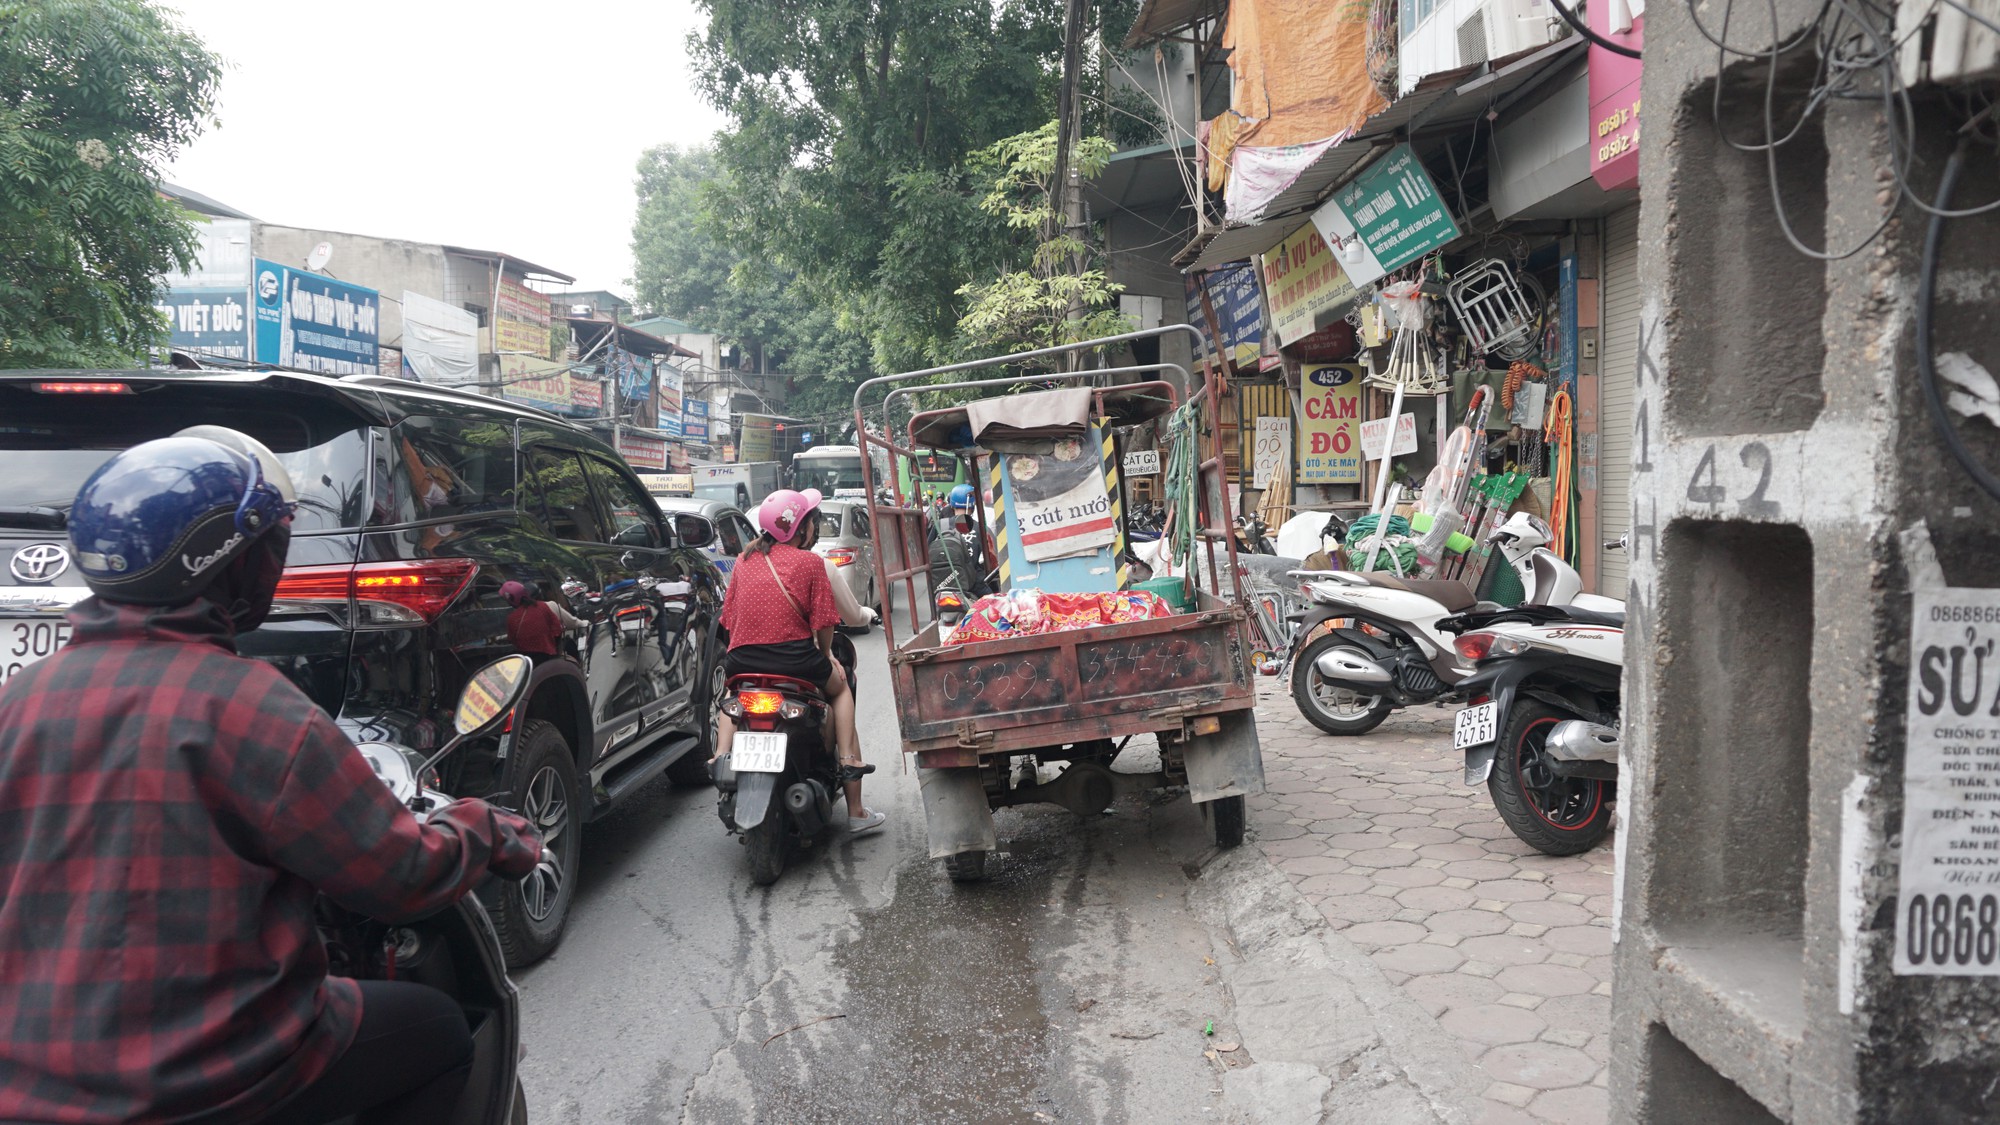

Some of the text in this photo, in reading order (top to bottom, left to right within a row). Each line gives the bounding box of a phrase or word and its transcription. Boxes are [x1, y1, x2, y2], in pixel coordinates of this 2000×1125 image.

[1352, 203, 1378, 228] THANH
[1292, 242, 1307, 269] VỤ
[178, 299, 210, 338] VIỆT
[212, 297, 243, 332] ĐỨC
[1318, 370, 1342, 383] 452
[1305, 388, 1357, 420] CẦM
[1310, 422, 1351, 454] ĐỒ
[1328, 459, 1337, 467] XE
[1340, 457, 1357, 467] MÁY
[1686, 441, 1782, 516] 42
[1032, 507, 1063, 527] cút
[1069, 495, 1110, 518] nướ
[182, 532, 244, 576] Vespa
[1546, 629, 1576, 639] SH
[1460, 705, 1490, 728] 29-E2
[1456, 723, 1492, 748] 247.61
[1934, 724, 1985, 740] CHỐNG
[736, 753, 780, 769] 177.84
[1932, 806, 1975, 822] ĐIỆN
[1933, 856, 1999, 865] KHOAN
[1908, 893, 1999, 965] 0868
